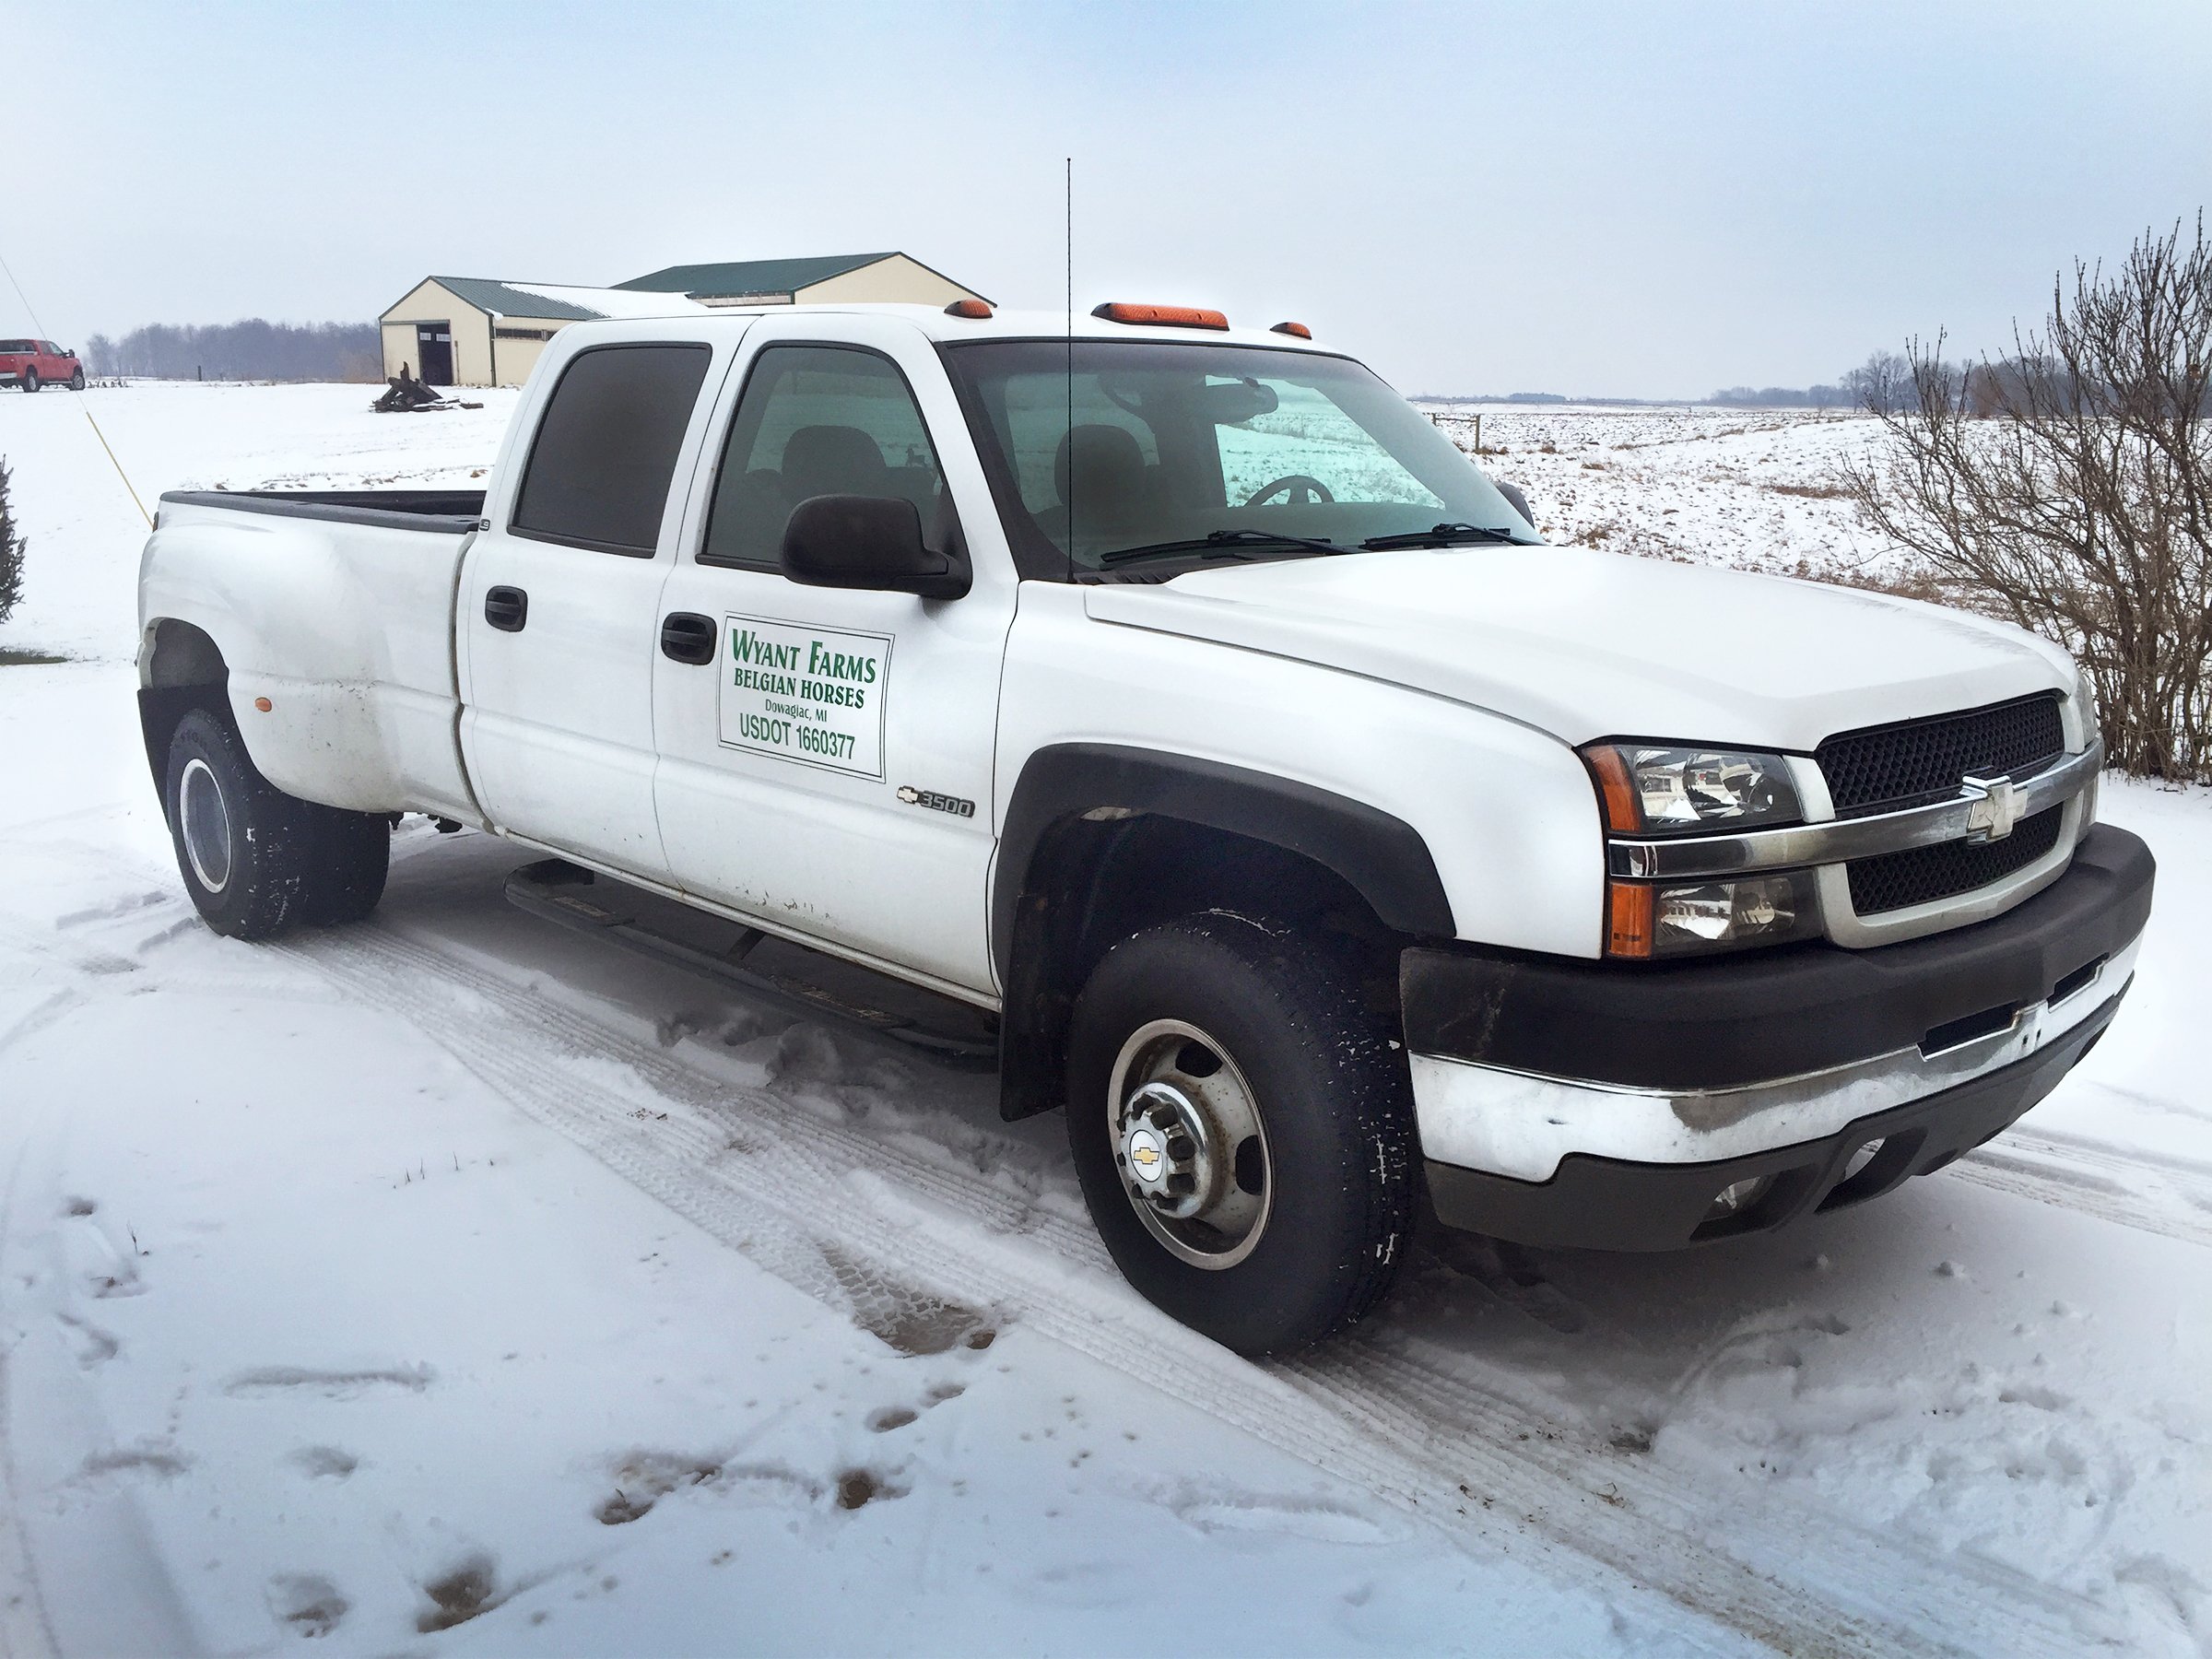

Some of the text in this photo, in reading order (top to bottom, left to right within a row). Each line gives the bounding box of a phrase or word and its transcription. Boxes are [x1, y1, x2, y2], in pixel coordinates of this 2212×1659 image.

[733, 629, 876, 684] WYANT FARMS
[735, 667, 865, 709] BELGIAN HORSES
[765, 699, 828, 723] Dowagiac, MI
[740, 712, 855, 759] USDOT 1660377
[921, 792, 972, 818] 3500
